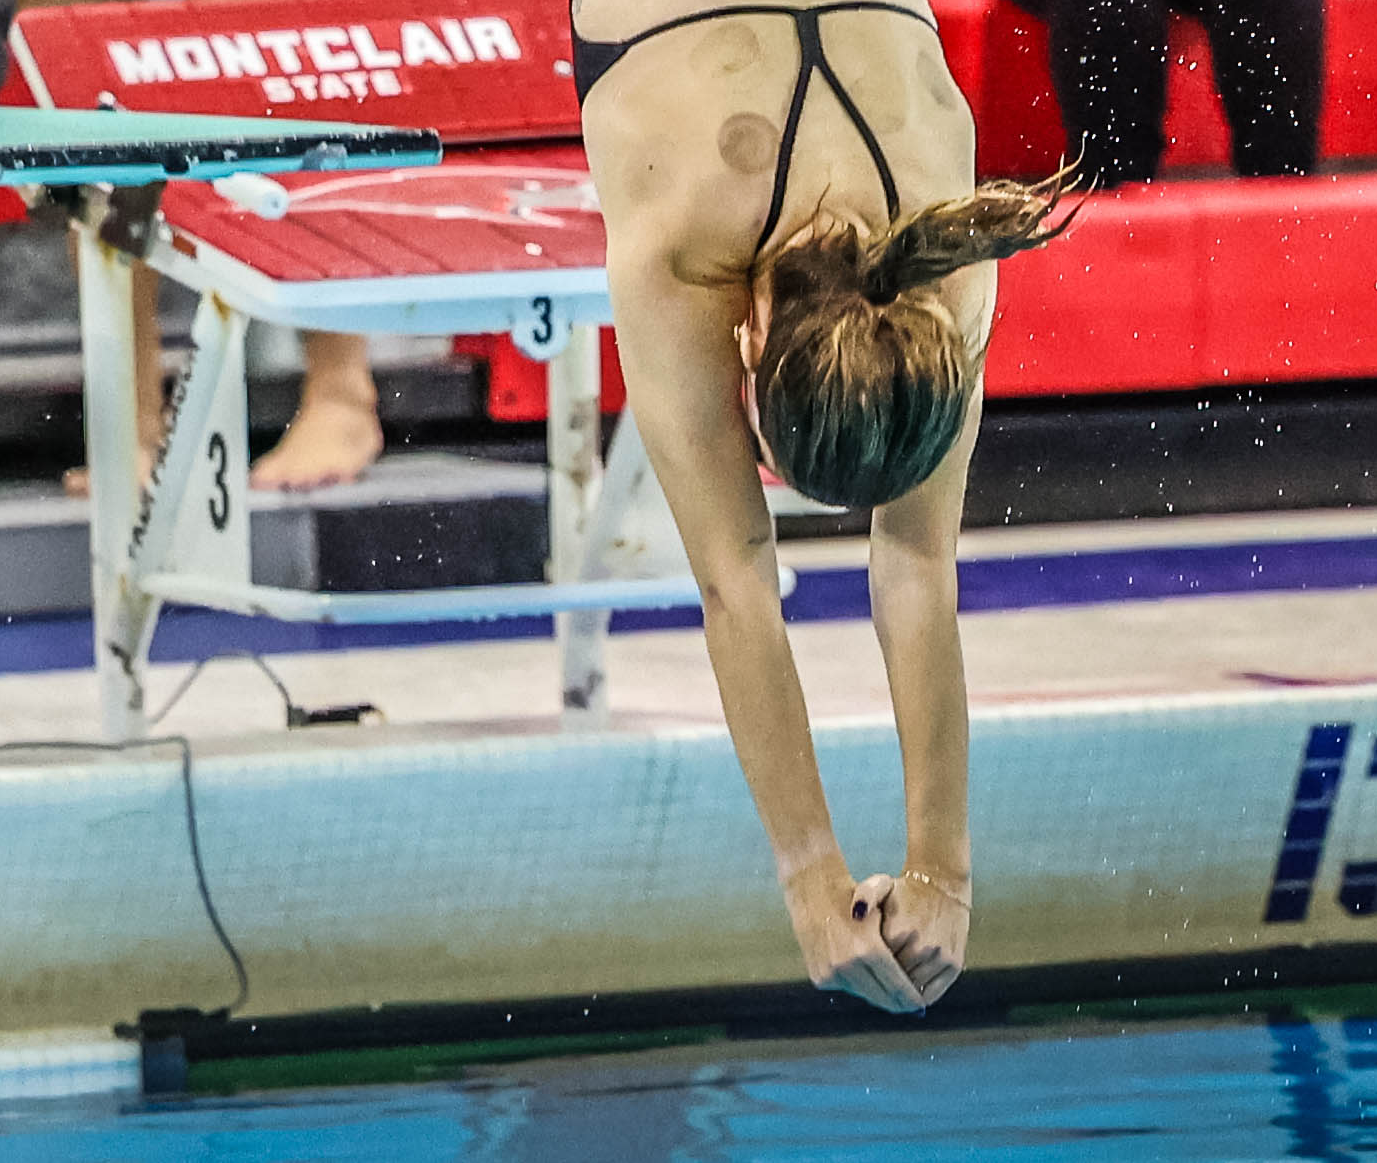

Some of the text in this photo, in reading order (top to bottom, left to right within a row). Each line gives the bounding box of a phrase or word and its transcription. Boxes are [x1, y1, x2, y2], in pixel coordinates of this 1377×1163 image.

[107, 16, 522, 85] MONTCLAIR
[261, 68, 402, 103] STATE
[532, 295, 553, 344] 3
[207, 431, 230, 531] 3
